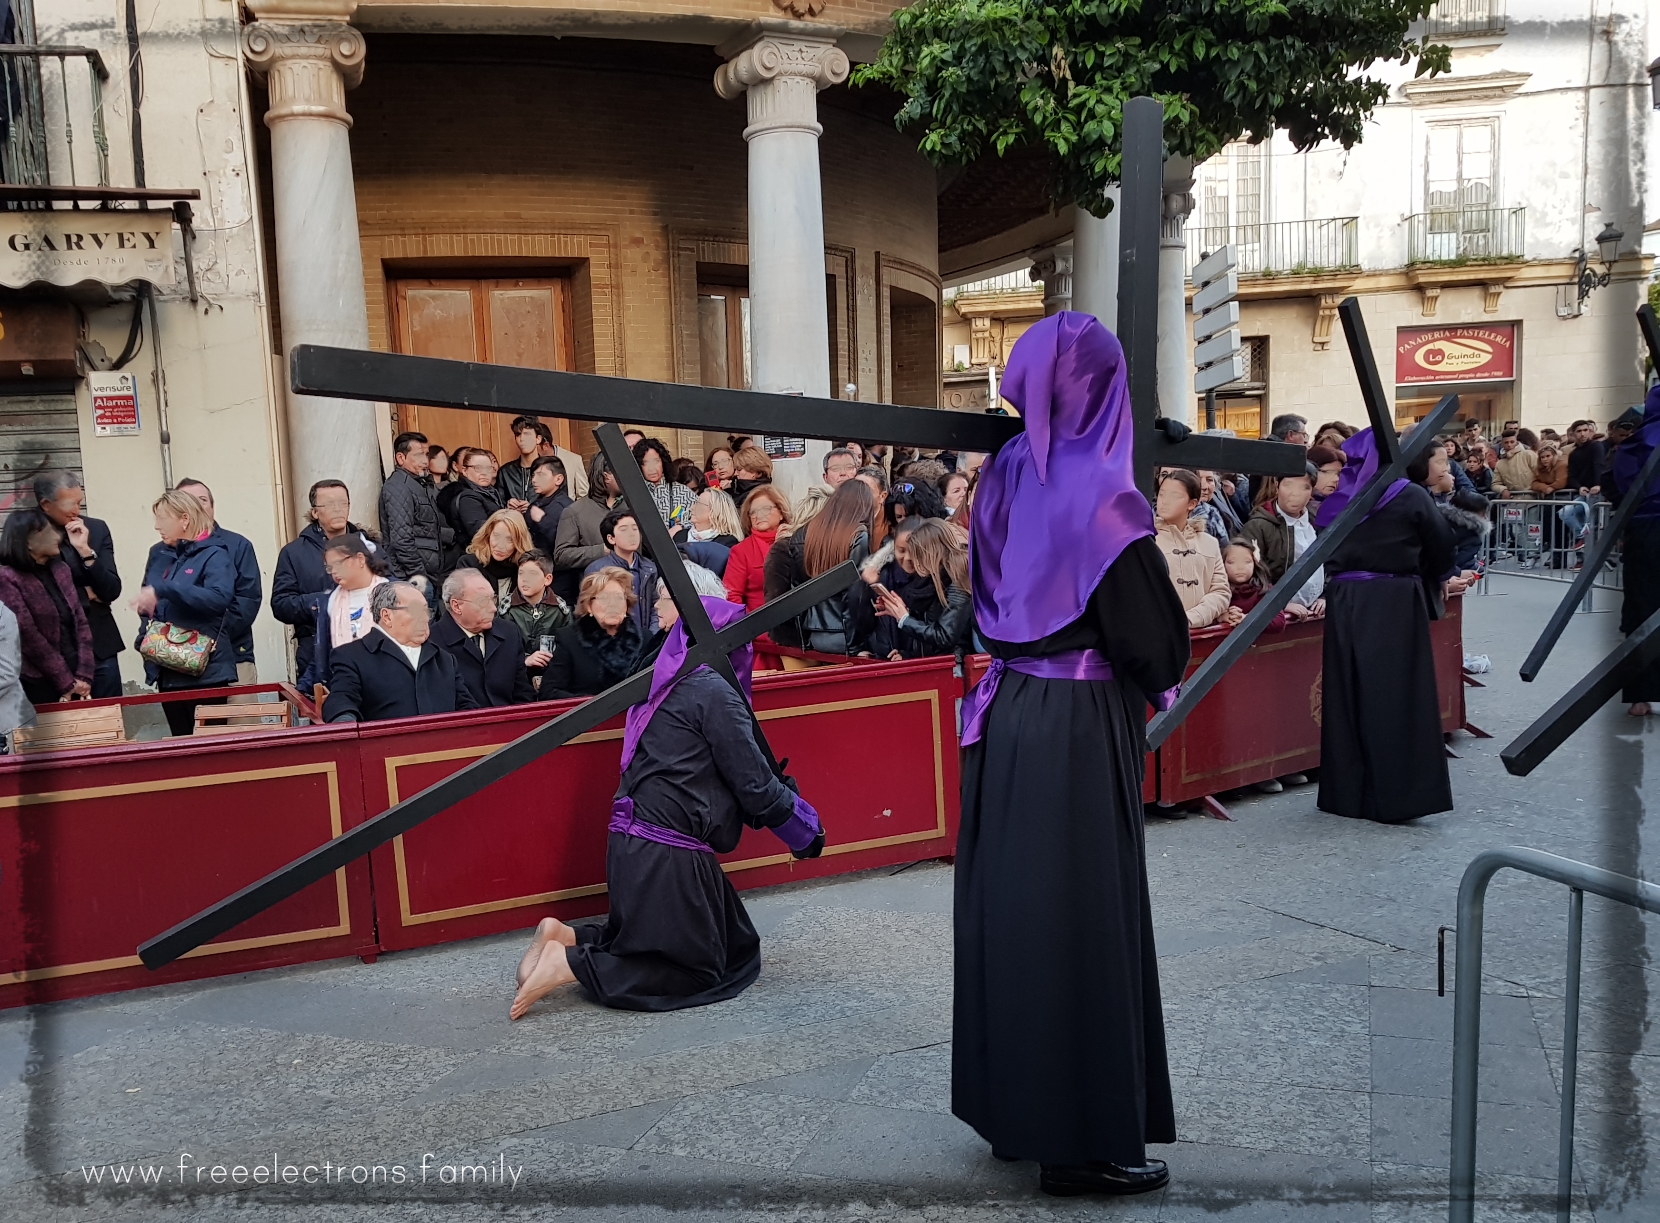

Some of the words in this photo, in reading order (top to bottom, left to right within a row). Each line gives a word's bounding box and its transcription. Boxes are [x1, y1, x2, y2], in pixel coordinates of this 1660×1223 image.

[8, 231, 162, 252] GARVEY
[53, 258, 89, 266] Desde
[1398, 330, 1450, 354] PANADERIA
[1456, 329, 1511, 348] PASTELERIA
[1429, 354, 1442, 362] La
[1446, 352, 1481, 360] Guinda
[93, 385, 132, 393] verisure
[95, 397, 134, 407] Alarma
